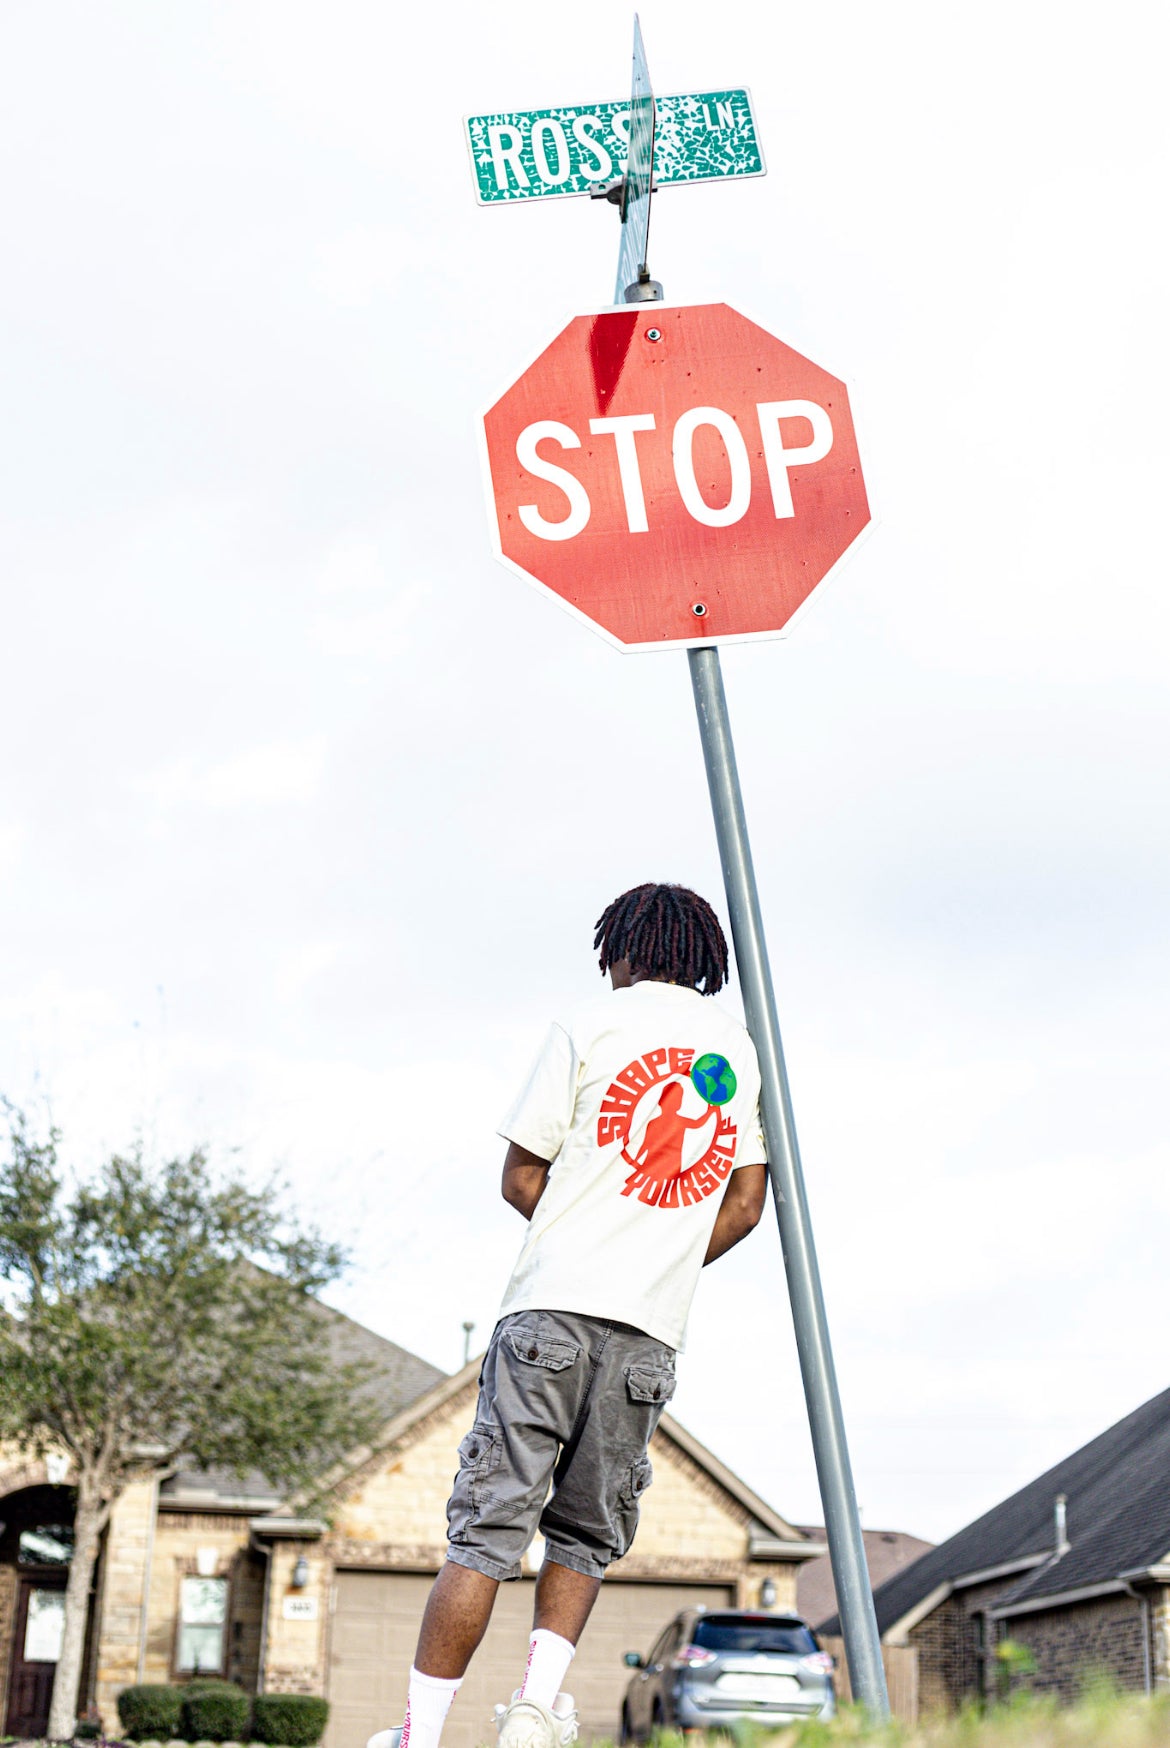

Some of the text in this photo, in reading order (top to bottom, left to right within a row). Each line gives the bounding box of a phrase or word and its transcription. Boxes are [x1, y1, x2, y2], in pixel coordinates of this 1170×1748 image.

[702, 99, 735, 131] LN
[515, 399, 834, 542] STOP
[597, 1047, 695, 1147] SHAPE
[620, 1116, 737, 1208] YOURSELF
